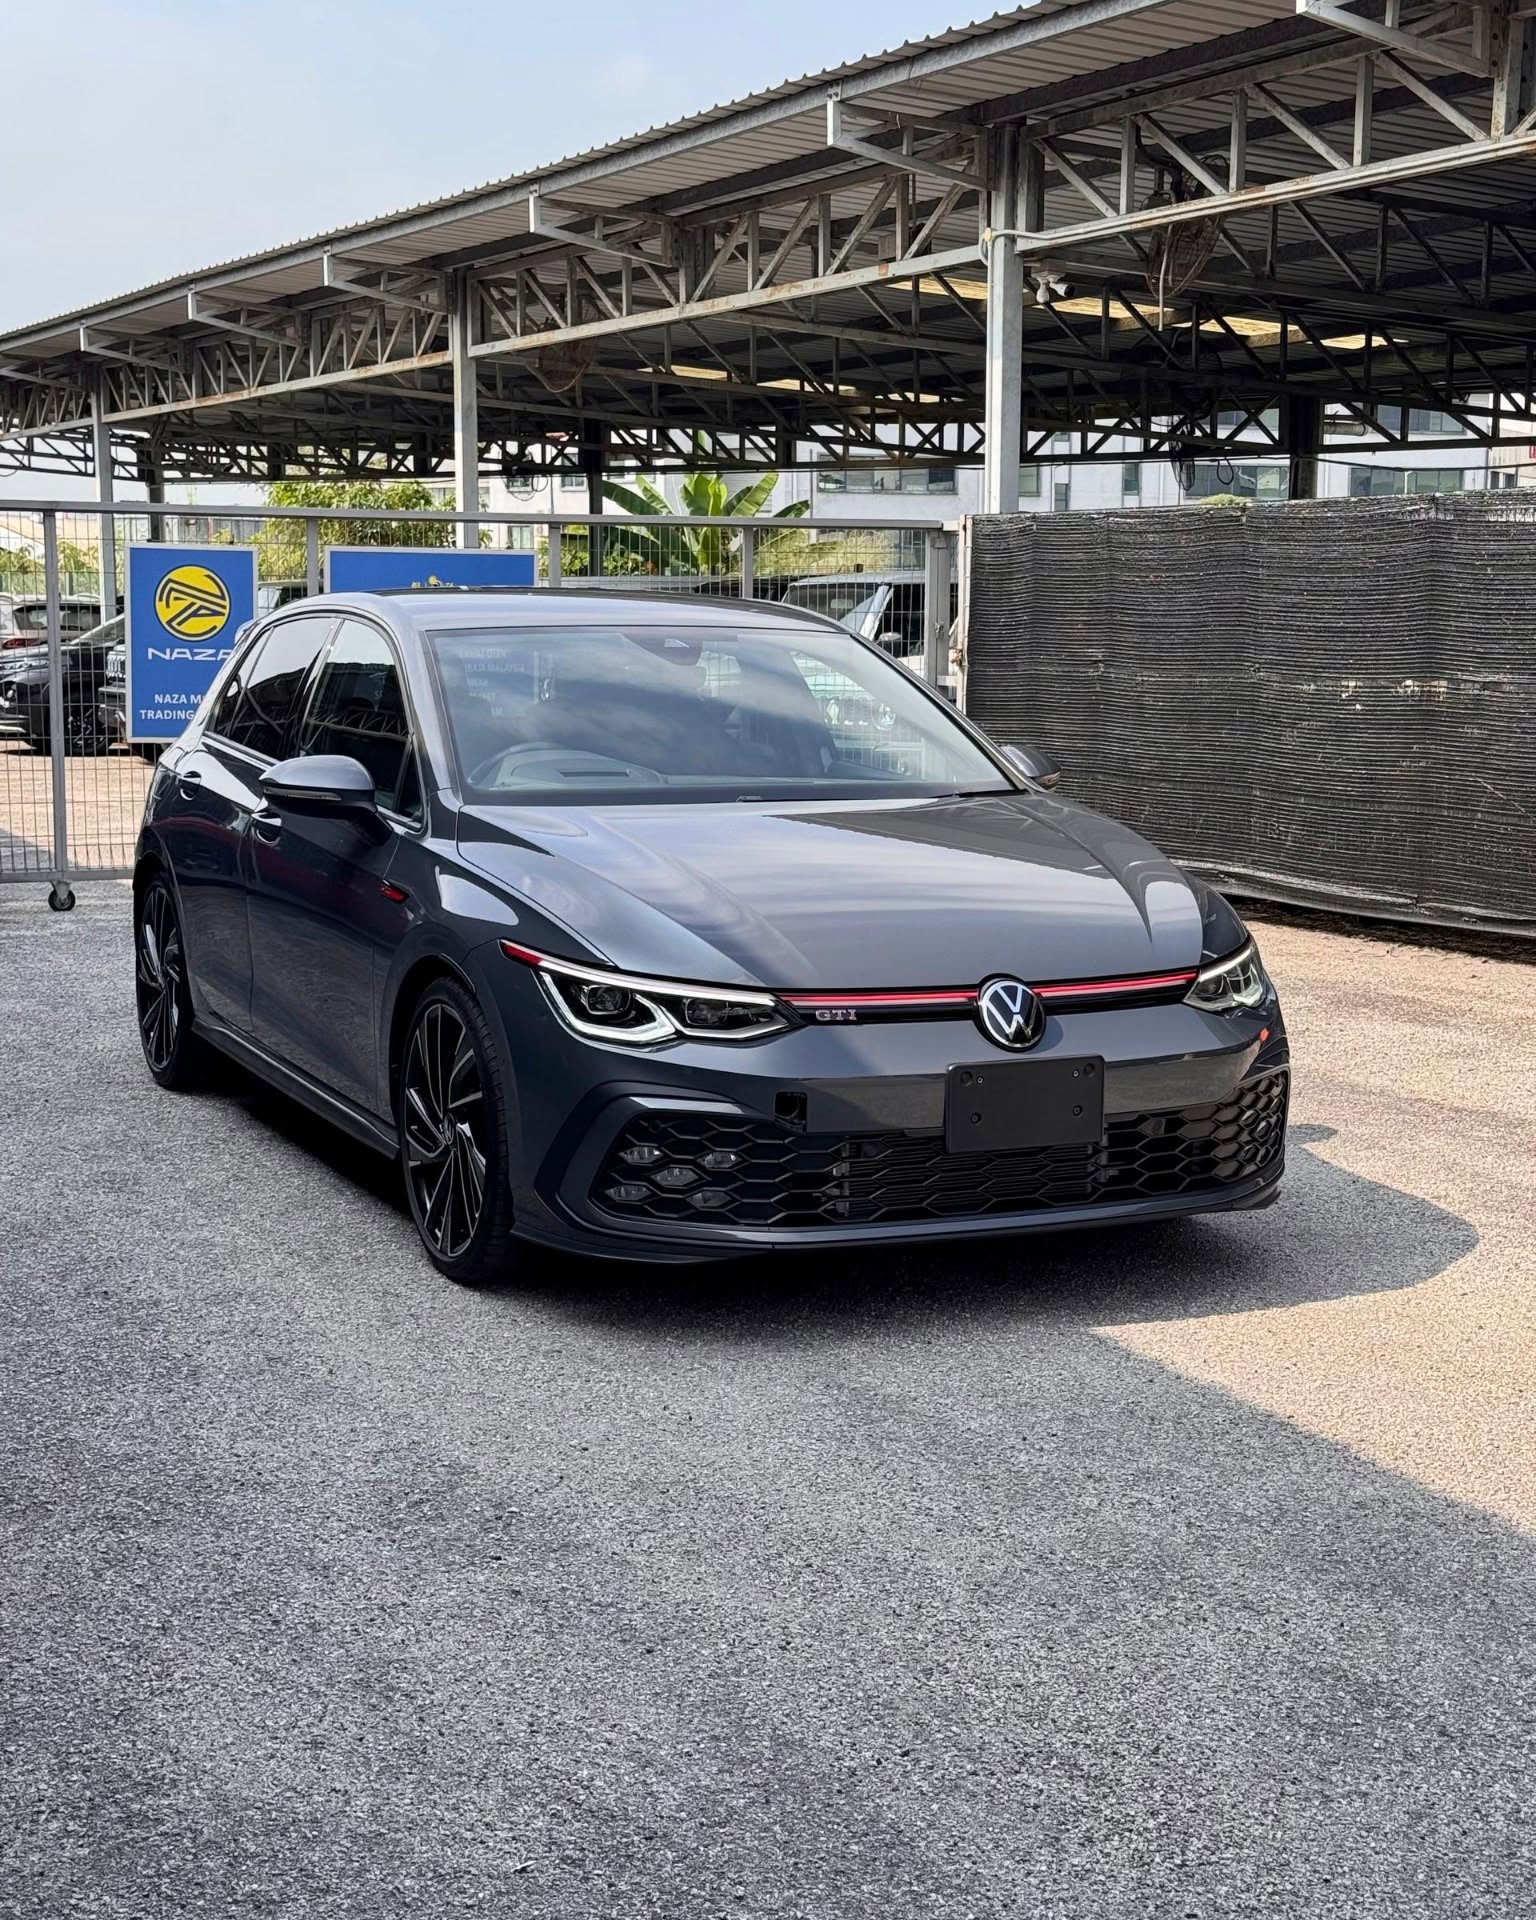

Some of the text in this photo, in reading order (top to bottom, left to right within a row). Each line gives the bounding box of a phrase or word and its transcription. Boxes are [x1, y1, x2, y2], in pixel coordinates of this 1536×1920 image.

[147, 647, 233, 661] NAZA
[154, 693, 187, 704] NAZA
[139, 709, 194, 720] TRADING
[815, 1009, 857, 1021] GTI
